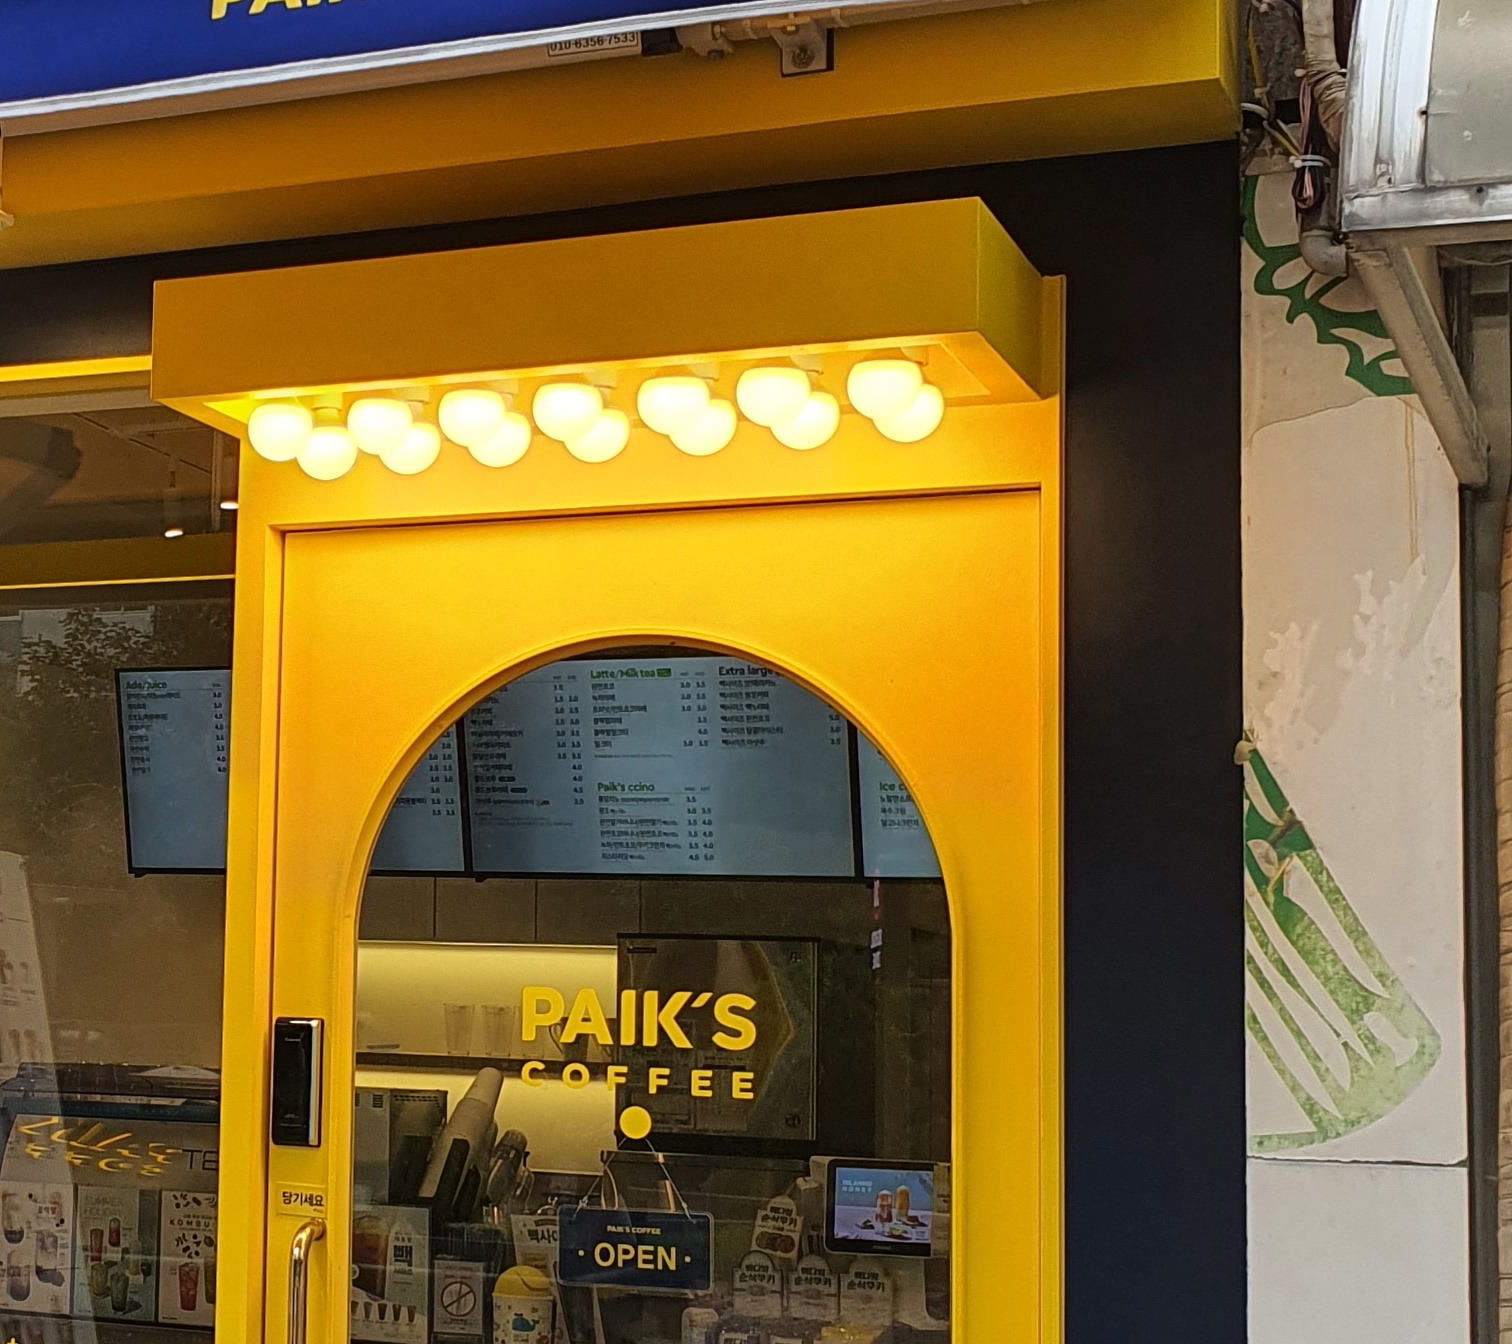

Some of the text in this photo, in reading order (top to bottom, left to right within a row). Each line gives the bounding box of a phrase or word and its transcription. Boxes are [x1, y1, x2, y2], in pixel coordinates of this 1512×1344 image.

[520, 985, 758, 1052] PAIK'S
[520, 1060, 755, 1100] COFFEE
[281, 1191, 324, 1208] 당기세요
[593, 1242, 677, 1271] OPEN
